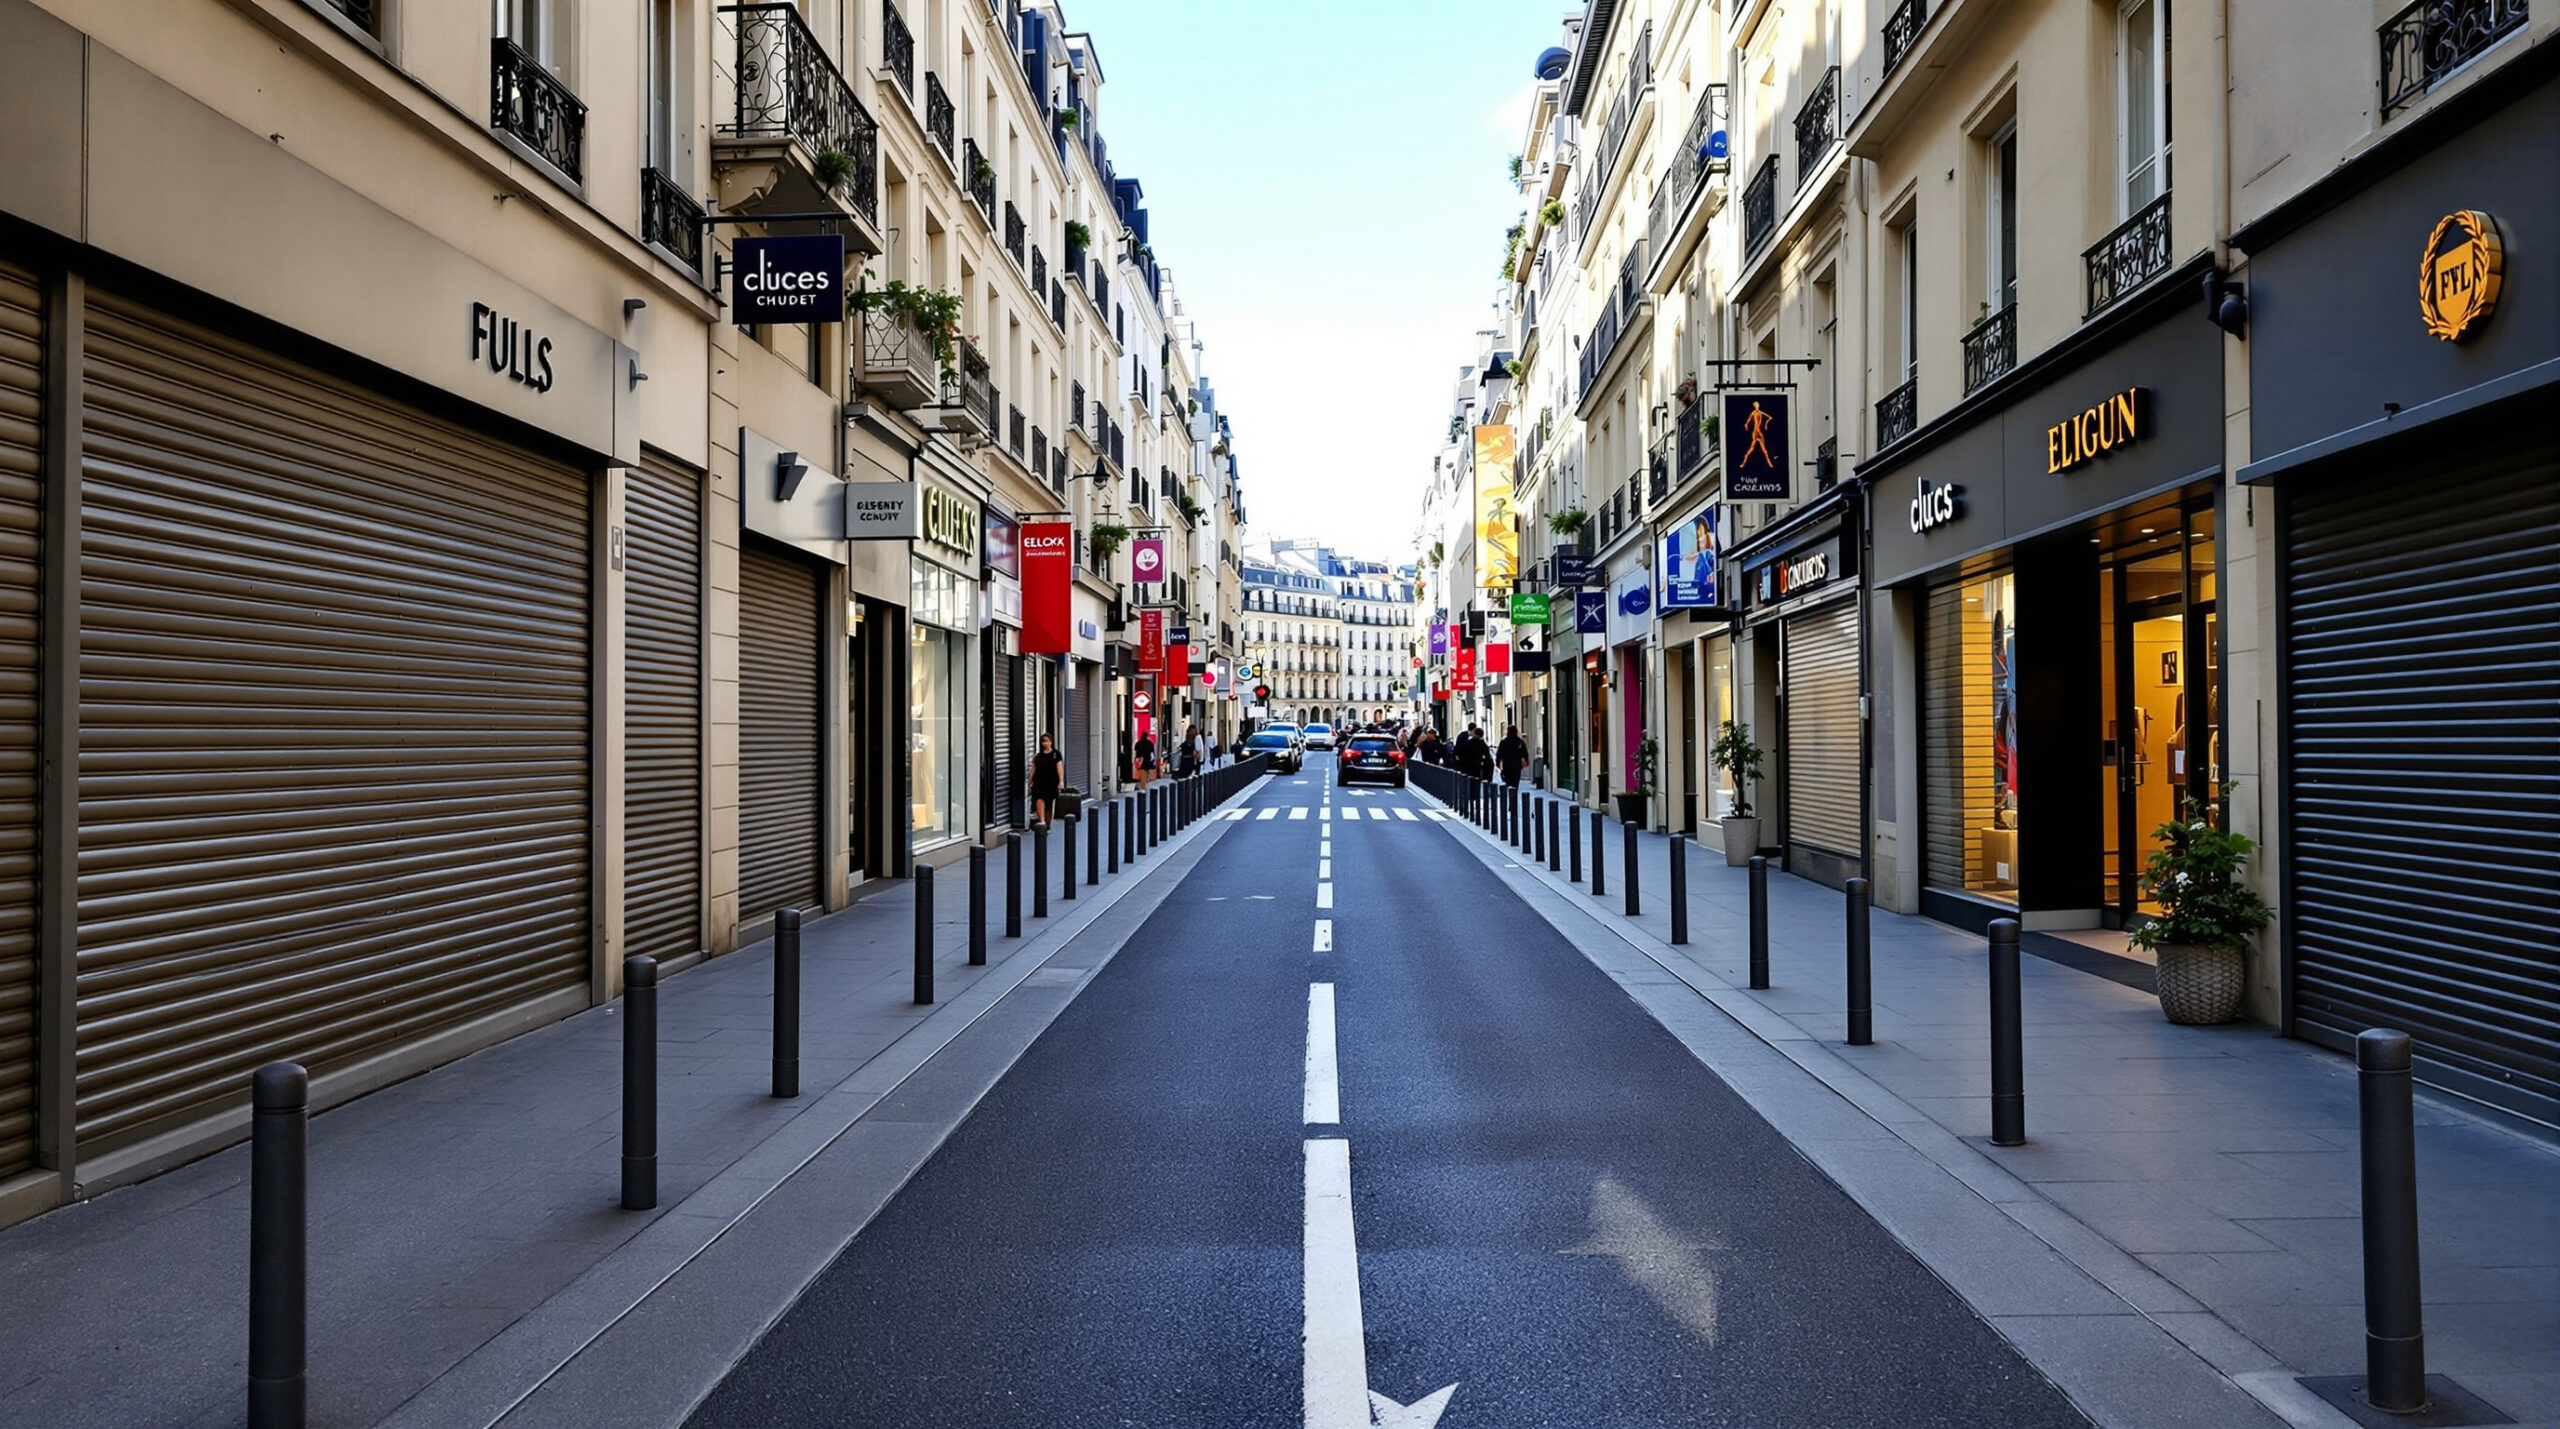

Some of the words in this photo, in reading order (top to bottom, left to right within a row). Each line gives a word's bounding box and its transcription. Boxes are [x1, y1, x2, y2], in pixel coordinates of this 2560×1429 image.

[756, 294, 817, 306] CHUDET
[471, 301, 553, 394] FULLS
[2047, 386, 2137, 475] ELIGUN
